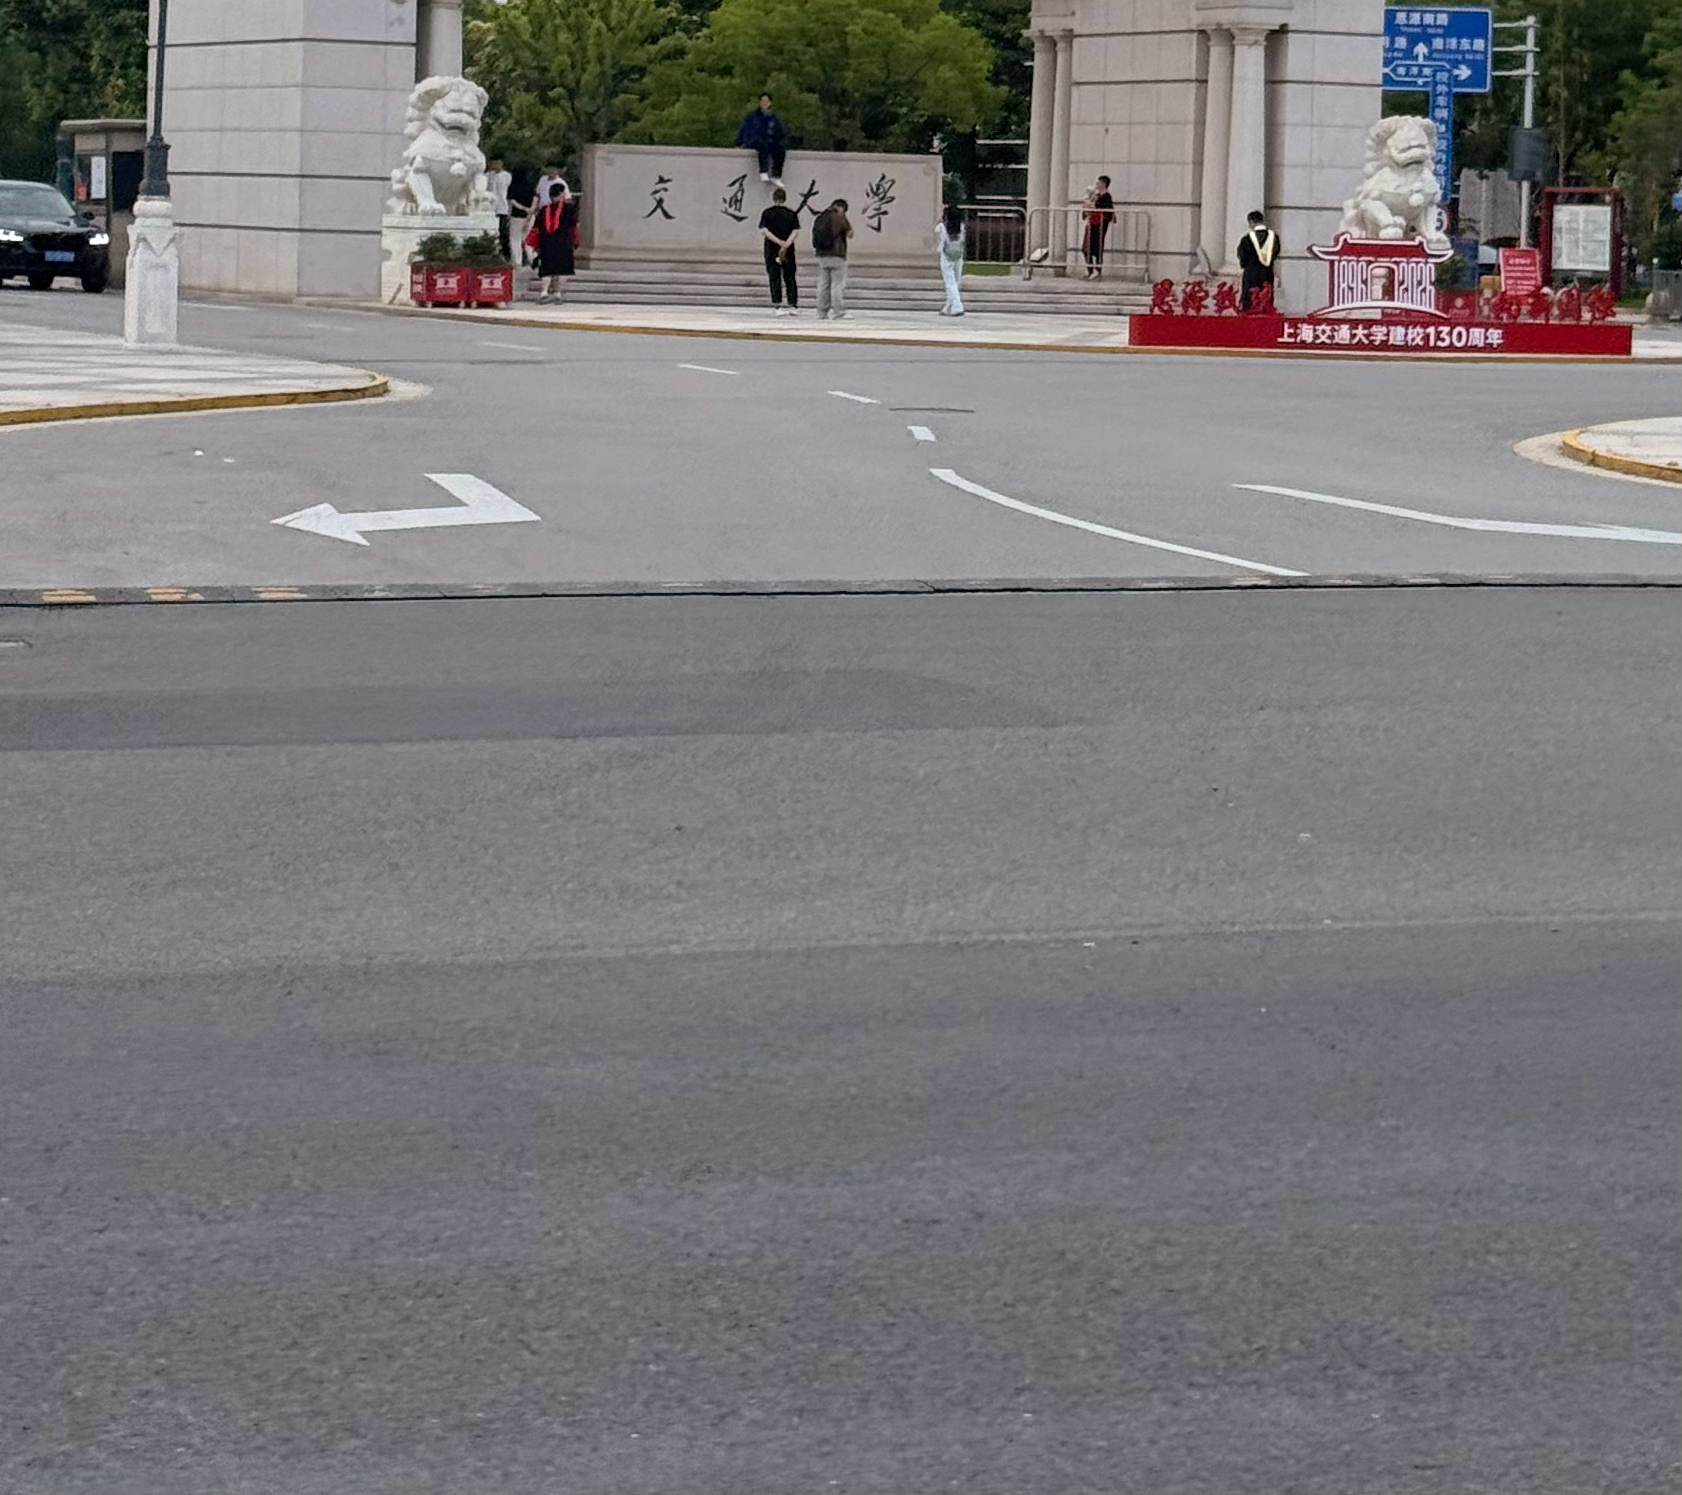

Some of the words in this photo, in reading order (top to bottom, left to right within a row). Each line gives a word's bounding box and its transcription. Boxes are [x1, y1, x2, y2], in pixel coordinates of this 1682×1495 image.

[1399, 263, 1435, 310] 2026
[1277, 322, 1504, 348] 上海交通大学建校130周年
